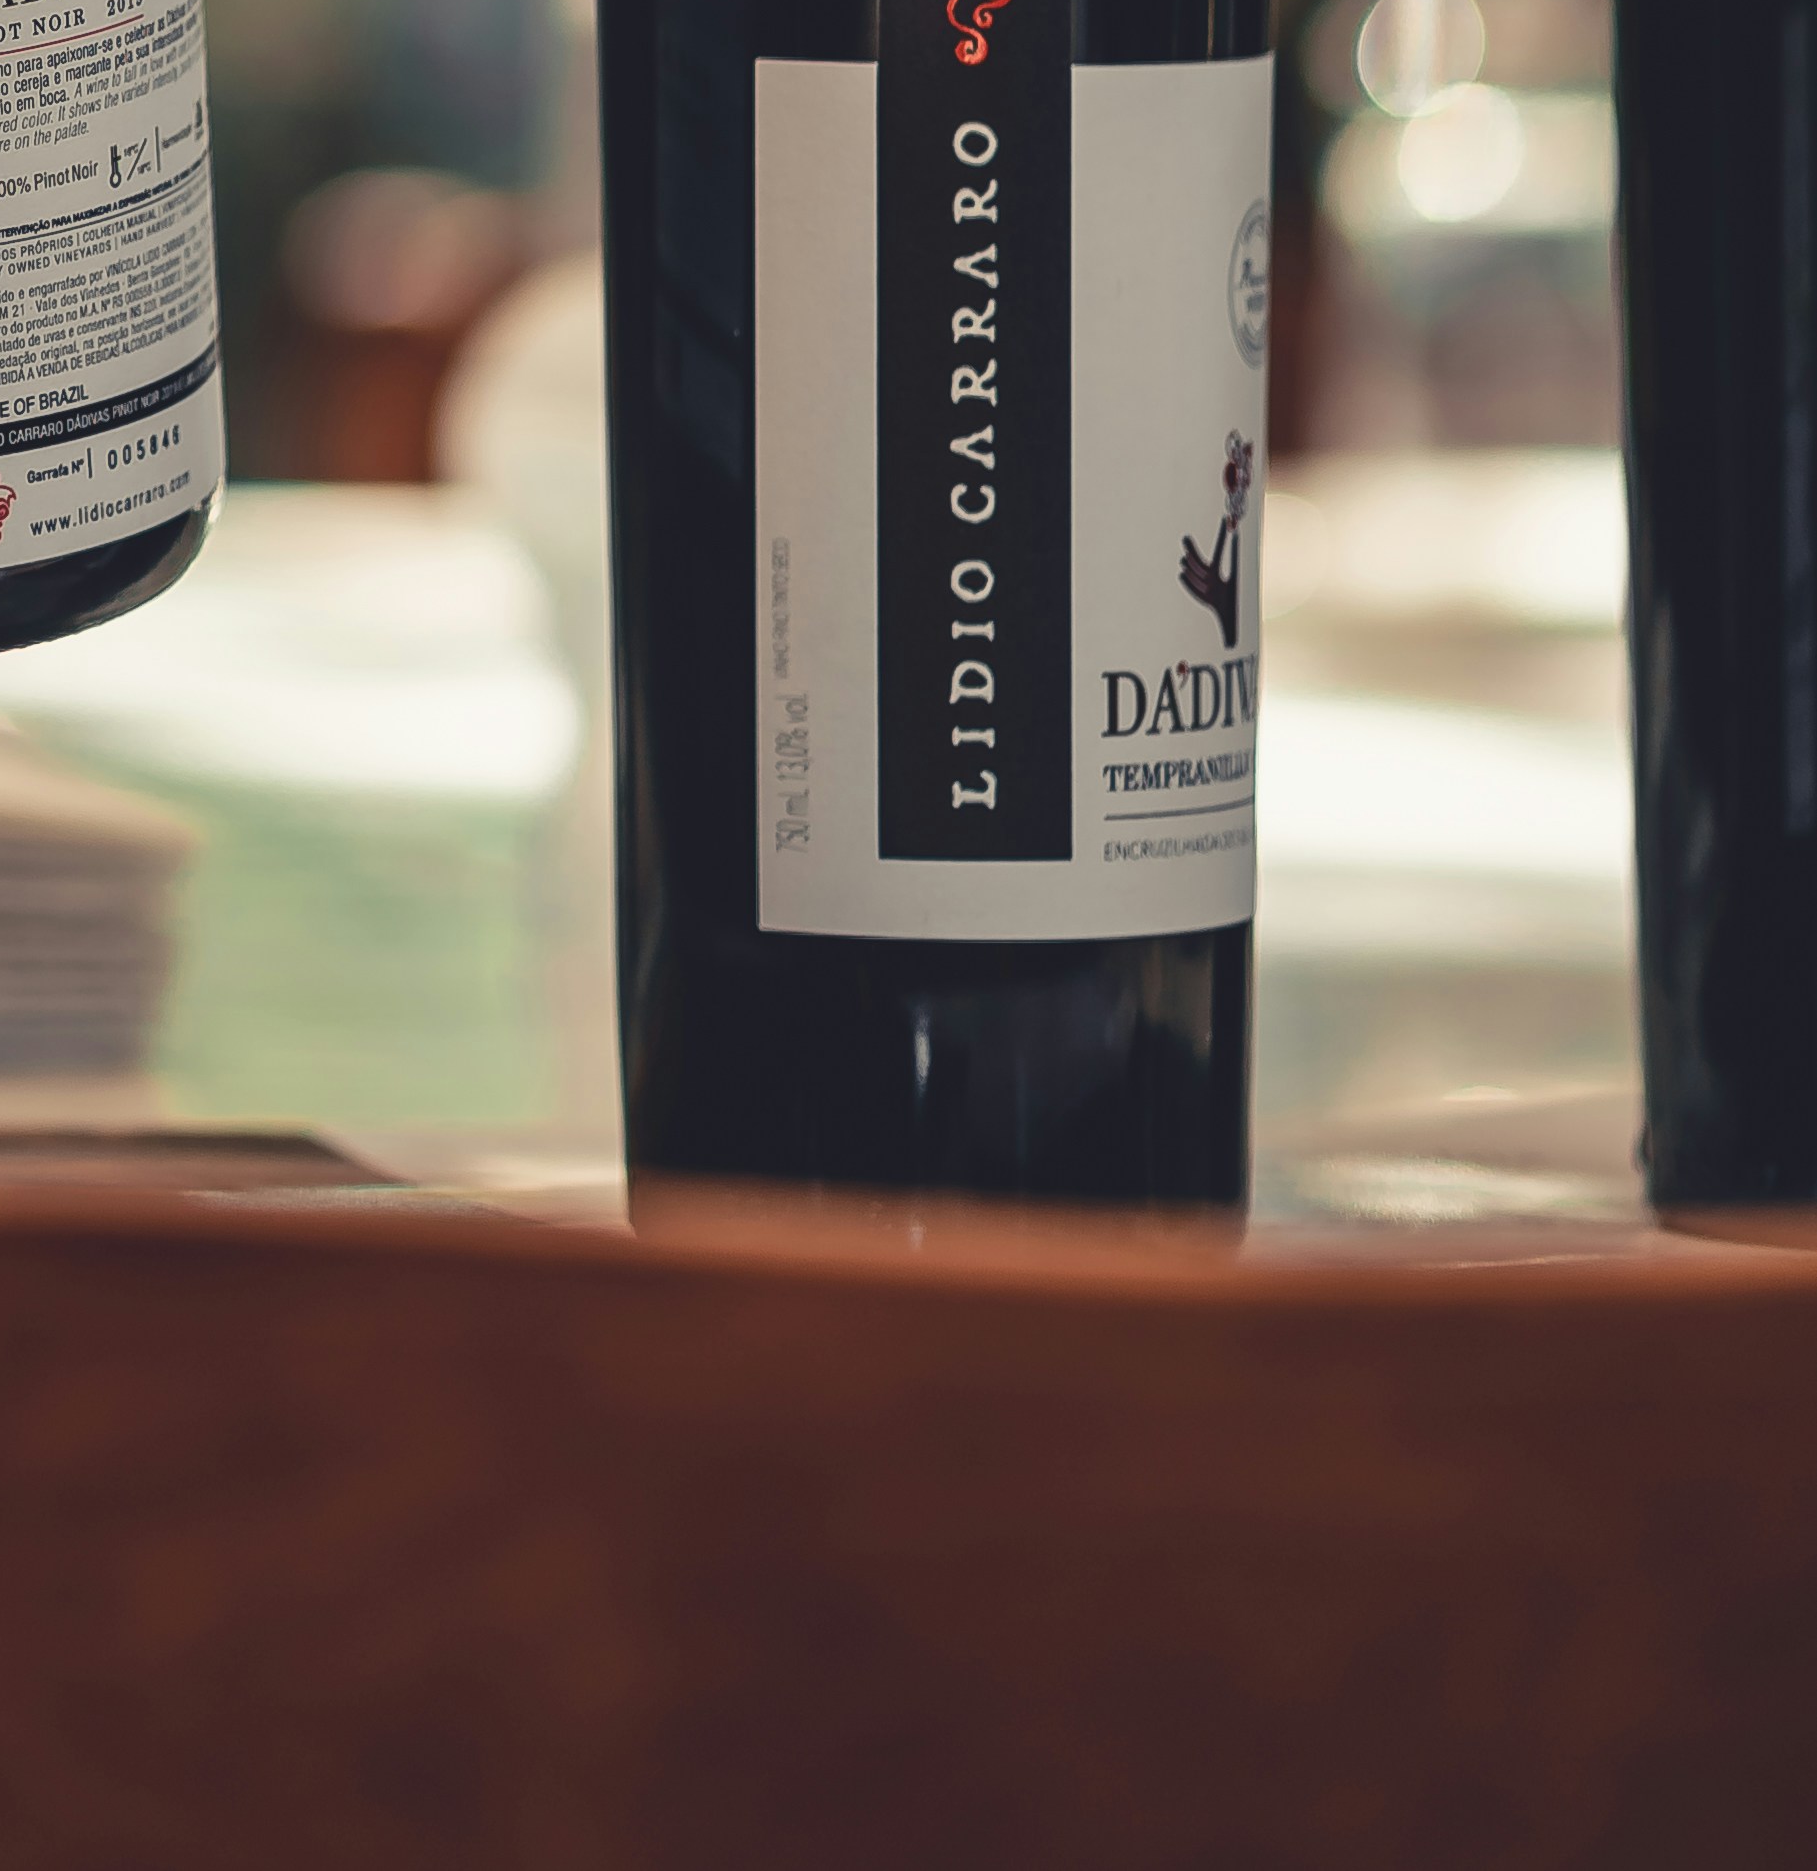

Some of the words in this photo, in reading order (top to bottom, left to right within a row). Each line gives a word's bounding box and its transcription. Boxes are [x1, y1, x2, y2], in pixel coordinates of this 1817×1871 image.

[32, 8, 86, 36] NOIR
[16, 57, 43, 78] para
[46, 36, 114, 70] apaixonar-se
[116, 35, 122, 49] e
[14, 72, 50, 94] cereja
[54, 71, 61, 85] e
[65, 56, 112, 83] marcante
[16, 96, 35, 112] em
[39, 88, 70, 108] boca.
[74, 82, 83, 99] A
[86, 77, 109, 96] wine
[111, 72, 122, 88] to
[22, 109, 54, 131] color.
[68, 98, 102, 119] shows
[104, 91, 119, 110] the
[14, 134, 30, 150] on
[33, 128, 52, 146] the
[54, 120, 90, 145] palate.
[34, 166, 71, 191] Pinot
[72, 159, 99, 182] Noir
[52, 213, 73, 228] PARA
[20, 235, 74, 258] PRÓPRIOS
[82, 220, 125, 243] COLHEITA
[7, 256, 51, 276] OWNED
[54, 240, 112, 265] VINEYARDS
[12, 304, 25, 318] 21
[35, 299, 58, 313] Vale
[60, 293, 78, 308] dos
[79, 280, 120, 302] Vinhedos
[18, 289, 25, 300] e
[28, 274, 86, 298] engarrafado
[89, 270, 103, 287] por
[10, 320, 24, 335] do
[26, 312, 64, 334] produto
[65, 309, 78, 322] no
[28, 333, 41, 347] de
[43, 327, 66, 344] uvas
[68, 327, 75, 338] e
[76, 311, 128, 337] conservante
[950, 120, 998, 525] CARRARO
[26, 366, 35, 381] A
[35, 358, 68, 379] VENDA
[71, 355, 83, 370] DE
[84, 343, 120, 367] BEBIDAS
[40, 340, 80, 362] original,
[82, 338, 94, 351] na
[13, 396, 35, 416] OF
[38, 384, 90, 411] BRAZIL
[8, 420, 64, 445] CARRARO
[27, 463, 69, 484] Garrafa
[30, 469, 190, 536] www.lidiocarraro.com
[951, 560, 998, 809] LIDIO
